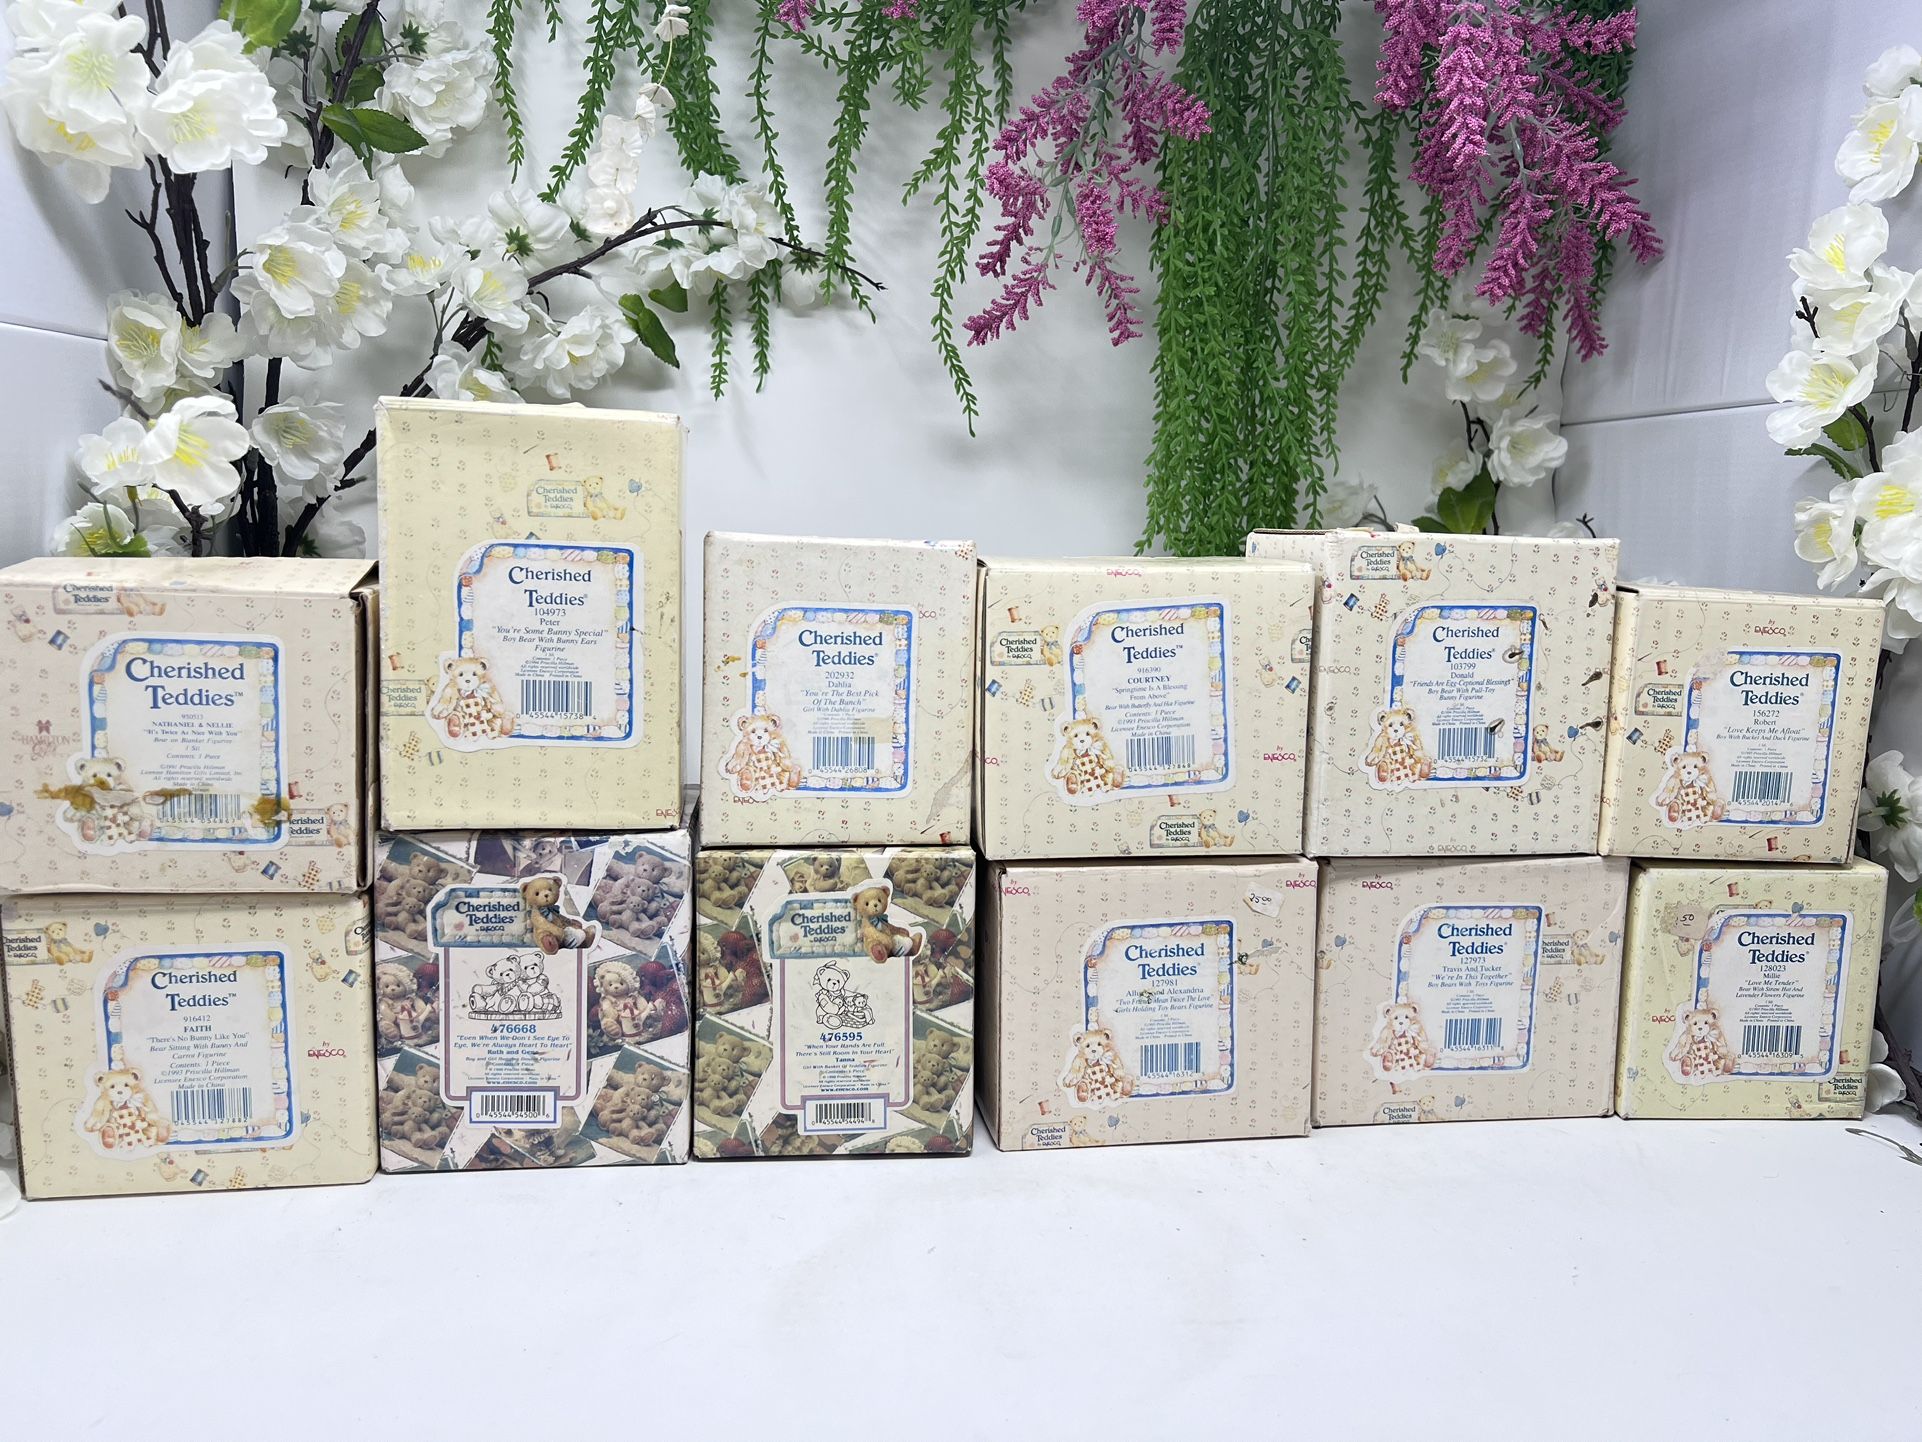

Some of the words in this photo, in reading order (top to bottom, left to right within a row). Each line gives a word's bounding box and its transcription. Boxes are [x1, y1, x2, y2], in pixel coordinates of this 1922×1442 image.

[535, 485, 578, 495] Cherished
[542, 495, 574, 503] Teddies
[1360, 550, 1395, 559] Cherished
[1366, 558, 1391, 566] Teddies
[509, 566, 591, 584] Cherished
[73, 593, 112, 604] Teddies
[534, 608, 566, 616] 104973
[539, 618, 560, 626] Peter
[1111, 623, 1184, 643] Cherished
[1433, 626, 1499, 642] Cherished
[556, 637, 578, 645] Bunny
[799, 630, 883, 647] Cherished
[1000, 638, 1037, 646] Cherished
[1006, 645, 1033, 653] Teddies
[126, 657, 245, 682] Cherished
[1128, 676, 1170, 684] COURTNEY
[1730, 671, 1808, 687] Cherished
[1163, 683, 1187, 691] Blessing
[385, 693, 417, 702] Teddies
[1647, 688, 1682, 698] Cherished
[1653, 695, 1677, 704] Teddies
[1159, 821, 1195, 830] Cherished
[1164, 828, 1192, 837] Teddies
[455, 901, 520, 914] Cherished
[791, 912, 851, 925] Cherished
[1438, 923, 1512, 939] Cherished
[1738, 931, 1815, 947] Cherished
[6, 944, 38, 952] Teddies
[1125, 943, 1204, 961] Cherished
[151, 971, 237, 989] Cherished
[190, 1034, 212, 1042] Bunny
[820, 1032, 862, 1042] 476595
[198, 1051, 227, 1059] Figurine
[1833, 1083, 1858, 1091] Teddies
[1383, 1106, 1416, 1115] Cherished
[1388, 1112, 1412, 1121] Teddies
[1030, 1126, 1066, 1135] Cherished
[1036, 1133, 1062, 1141] Teddies
